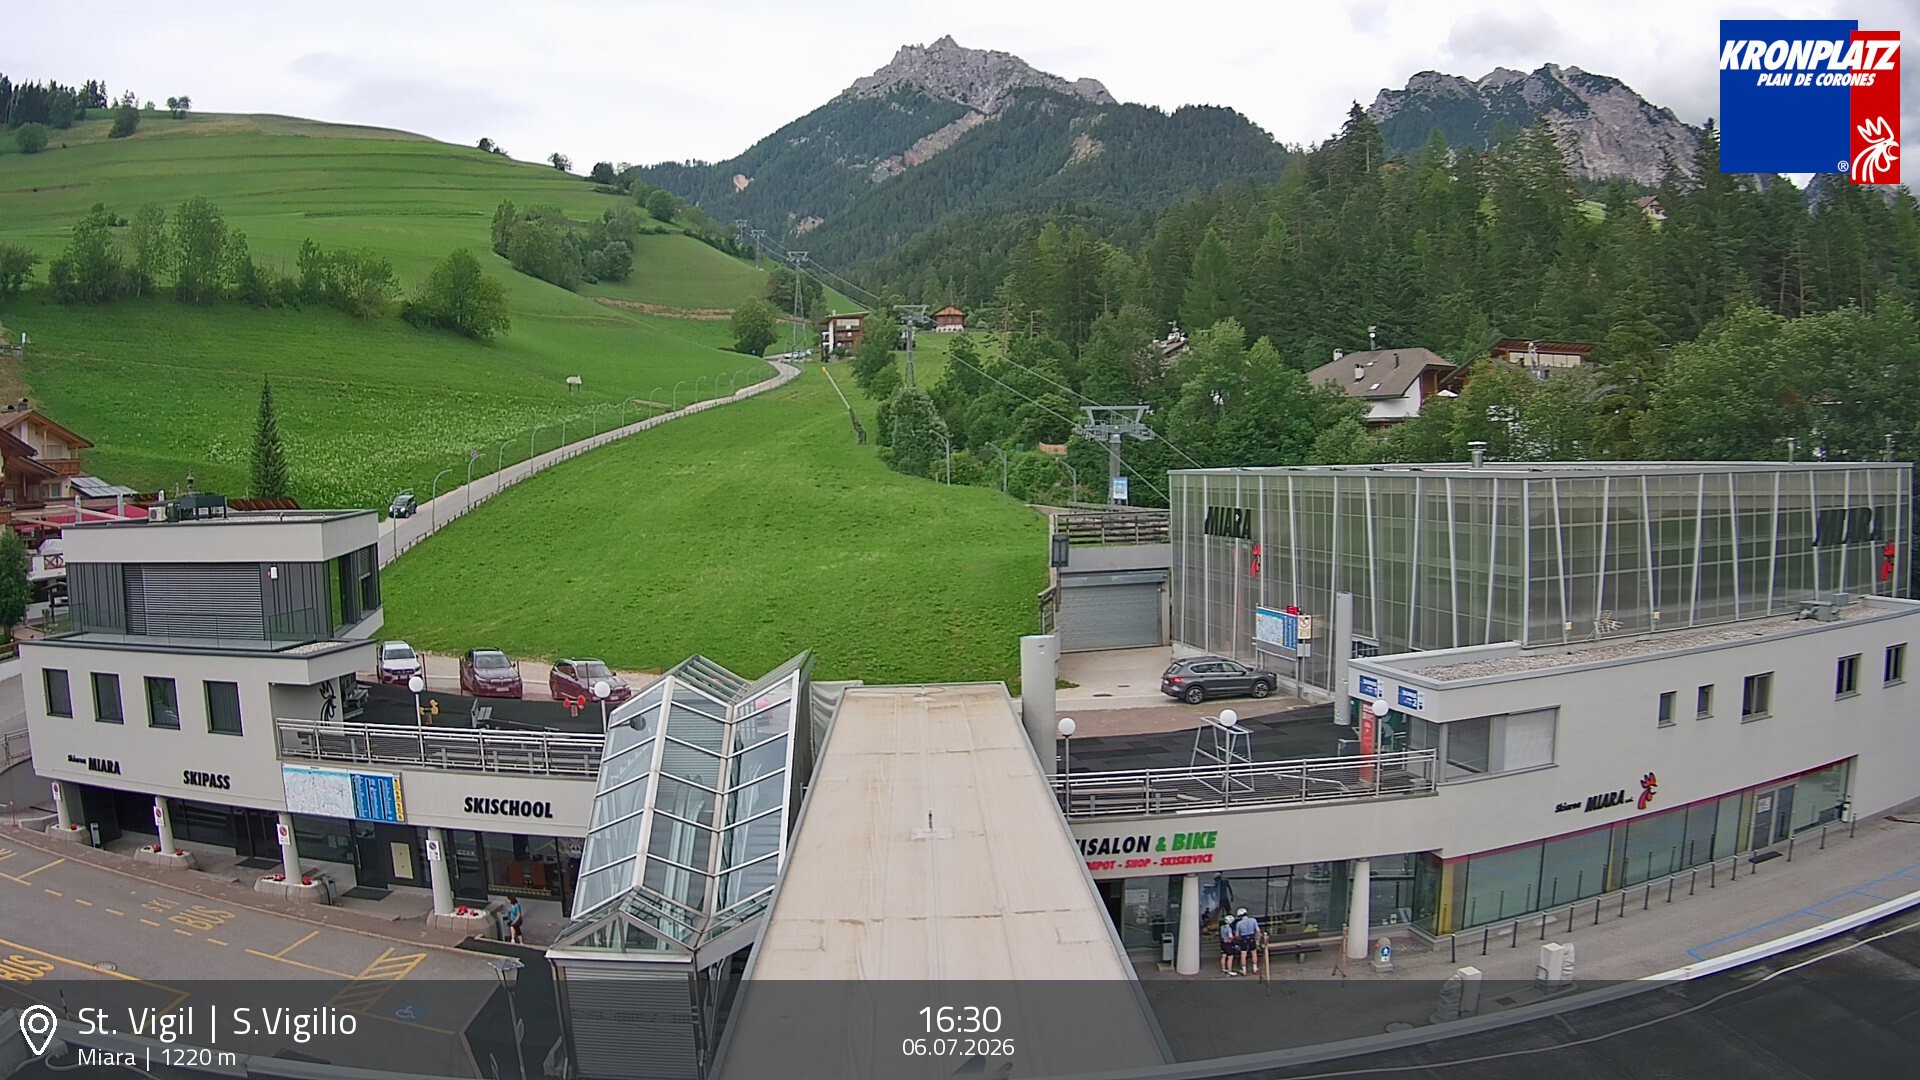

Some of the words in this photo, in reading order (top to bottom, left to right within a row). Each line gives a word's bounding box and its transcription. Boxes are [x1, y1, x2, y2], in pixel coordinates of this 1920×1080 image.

[1204, 506, 1252, 540] MIARA
[88, 757, 121, 775] MIARA
[183, 770, 231, 790] SKIPASS
[464, 797, 553, 818] SKISCHOOL
[1584, 789, 1625, 813] MIARA
[1075, 835, 1152, 857] ISALON
[1155, 836, 1167, 852] &
[1172, 831, 1218, 851] BIKE
[1125, 858, 1152, 869] SHOP
[1160, 853, 1214, 867] SKISERVICE
[141, 897, 180, 913] SKI
[168, 904, 236, 931] BUS
[0, 954, 55, 986] BUS
